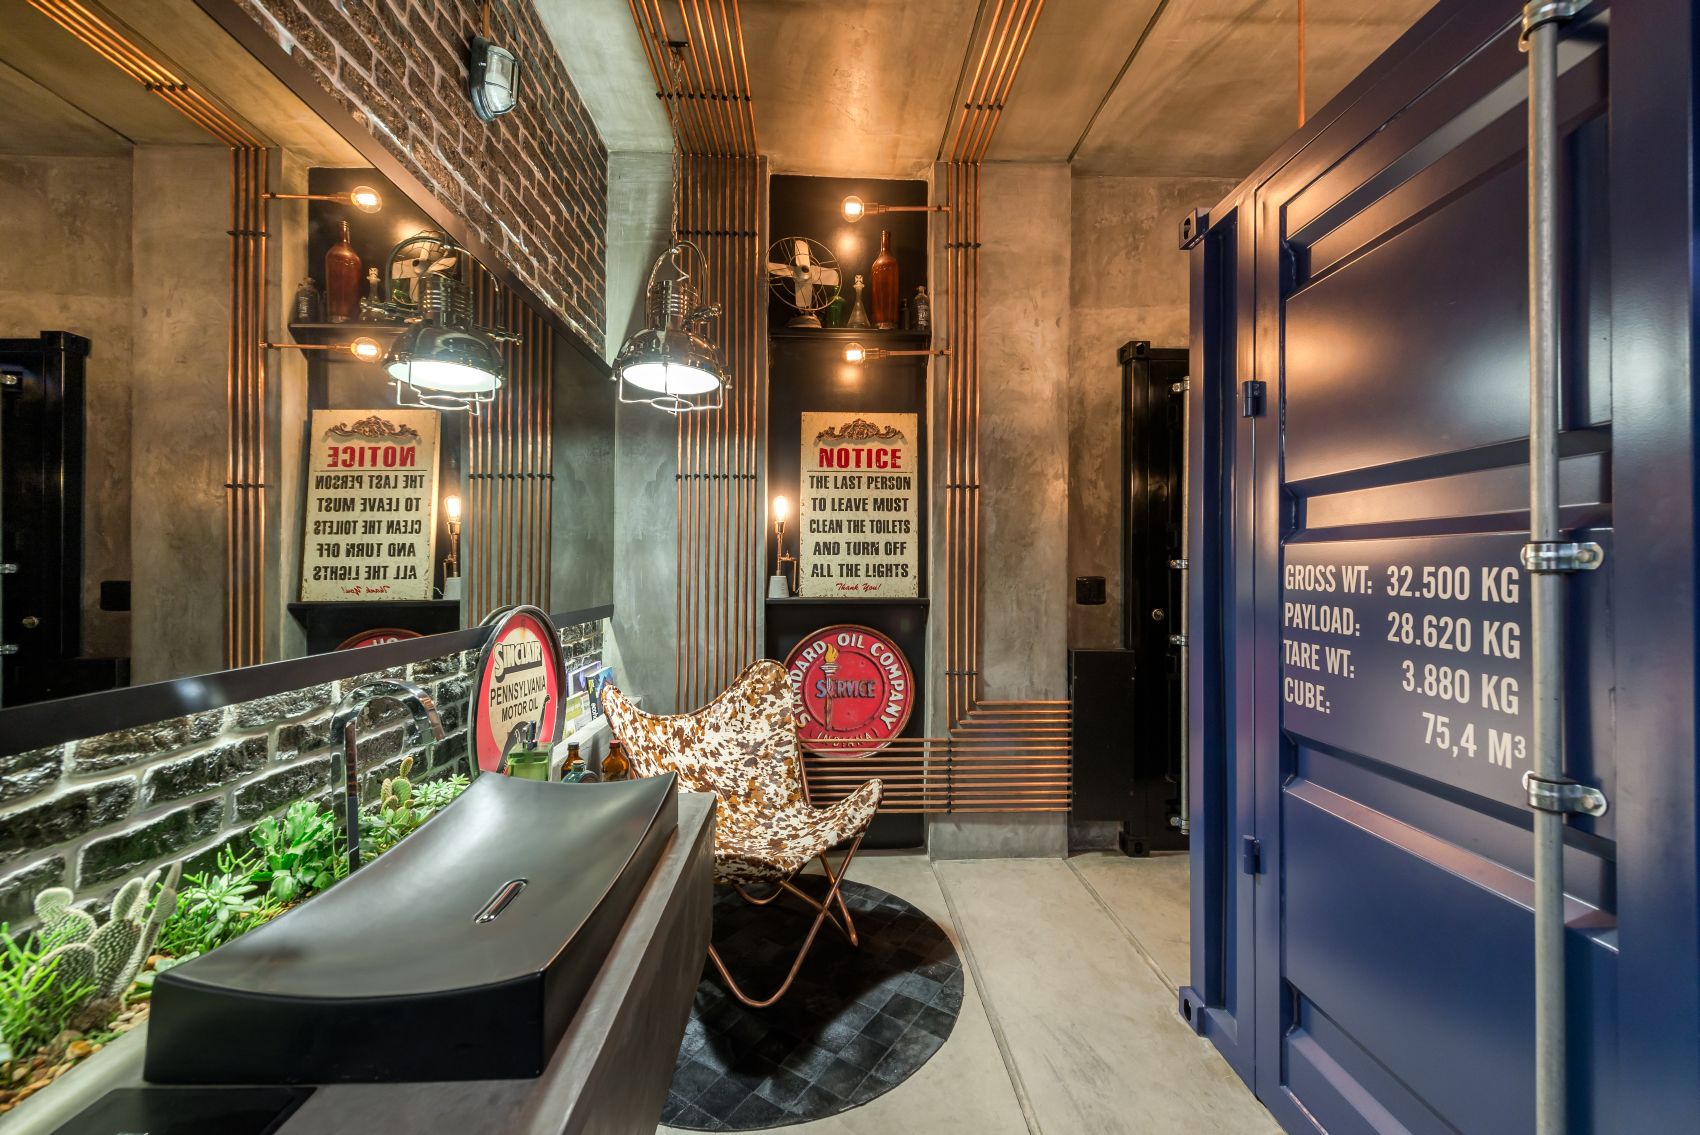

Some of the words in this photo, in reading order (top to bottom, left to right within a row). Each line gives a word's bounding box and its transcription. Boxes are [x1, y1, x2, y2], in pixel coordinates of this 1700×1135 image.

[819, 448, 902, 469] NOTICE
[809, 475, 830, 490] THE
[834, 475, 863, 490] LAST
[866, 476, 911, 490] PERSON
[811, 497, 826, 511] TO
[831, 497, 869, 512] LEAVE
[872, 498, 909, 512] MUST
[809, 519, 843, 533] CLEAN
[847, 519, 866, 533] THE
[869, 520, 910, 534] TOILETS
[813, 541, 841, 556] AND
[845, 542, 880, 556] TURN
[884, 542, 907, 556] OFF
[810, 564, 833, 578] ALL
[838, 563, 861, 578] THE
[865, 563, 908, 578] LIGHTS
[836, 583, 859, 591] Thank
[862, 583, 881, 592] You!
[1285, 565, 1336, 593] GROSS
[1342, 566, 1372, 594] WT:
[1386, 565, 1470, 601] 32.500
[1481, 567, 1520, 604] KG
[1284, 603, 1360, 636] PAYLOAD:
[1387, 612, 1471, 653] 28.620
[1482, 620, 1521, 659] KG
[494, 641, 542, 680] SINCLAIR
[790, 640, 826, 728] STANDARD
[837, 633, 864, 648] OIL
[870, 642, 904, 730] COMPANY
[1284, 640, 1320, 671] TARE
[1325, 647, 1355, 678] WT:
[1402, 660, 1470, 704] 3.880
[1481, 674, 1519, 715] KG
[490, 676, 546, 707] PENNSYLVANIA
[501, 702, 527, 722] MOTOR
[529, 699, 538, 712] OIL
[1284, 677, 1331, 714] CUBE:
[1422, 712, 1477, 758] 75,4
